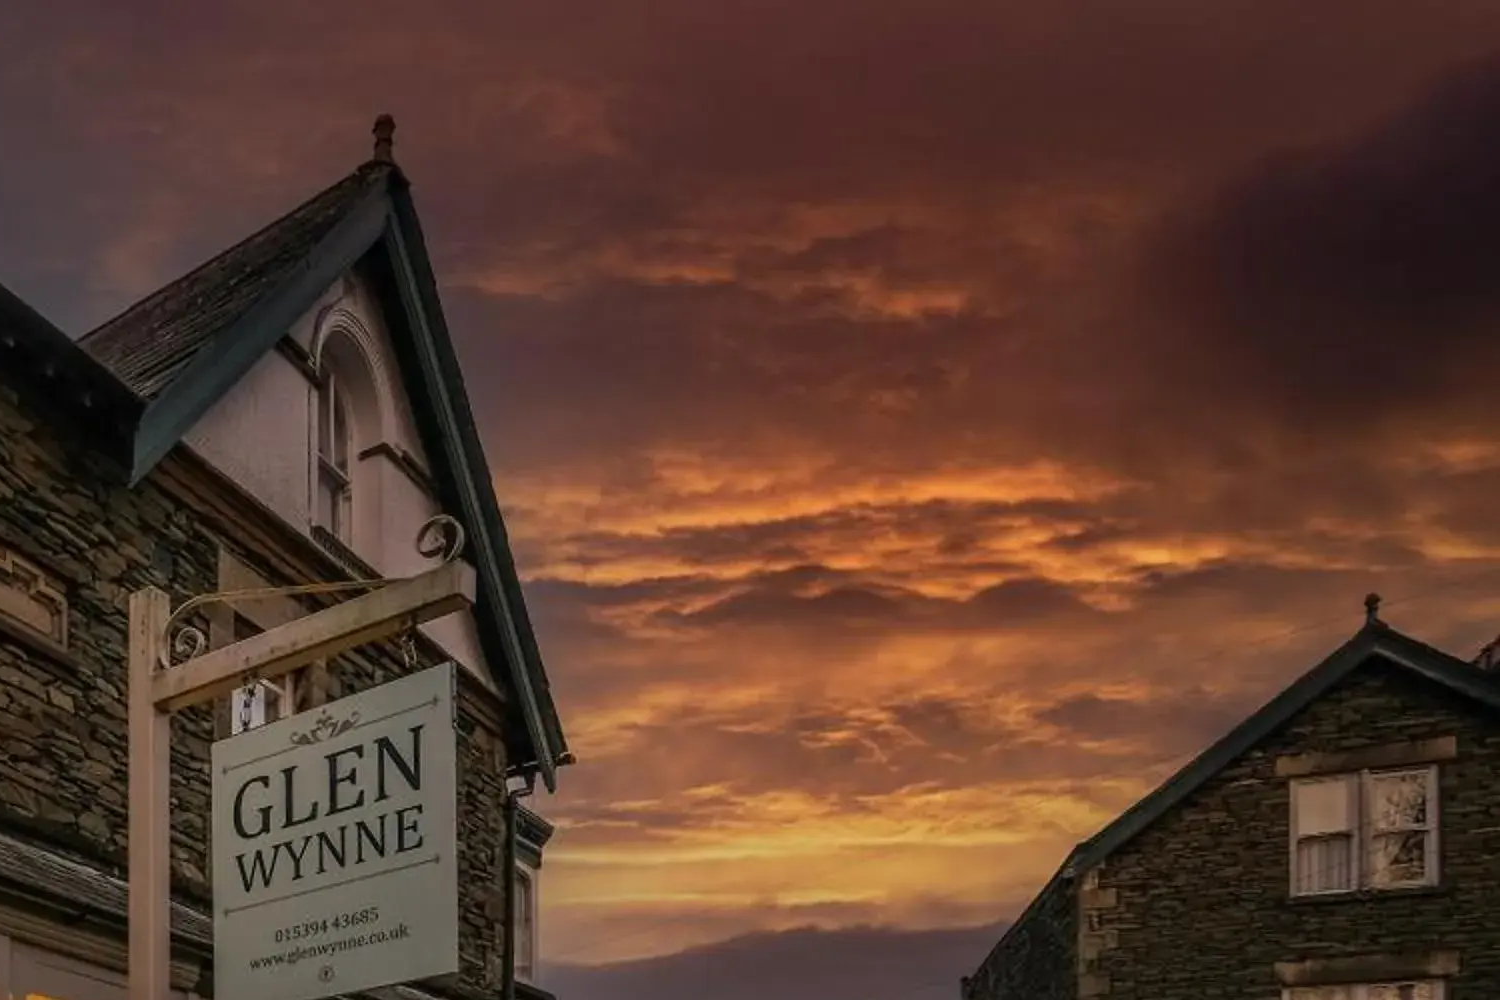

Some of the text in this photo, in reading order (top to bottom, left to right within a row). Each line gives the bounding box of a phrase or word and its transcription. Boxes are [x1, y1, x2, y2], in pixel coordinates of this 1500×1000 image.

[233, 724, 424, 839] GLEN
[235, 805, 424, 893] WYNNE
[249, 923, 410, 969] www.glenwynne.co.uk
[275, 907, 379, 943] 015394 43685
